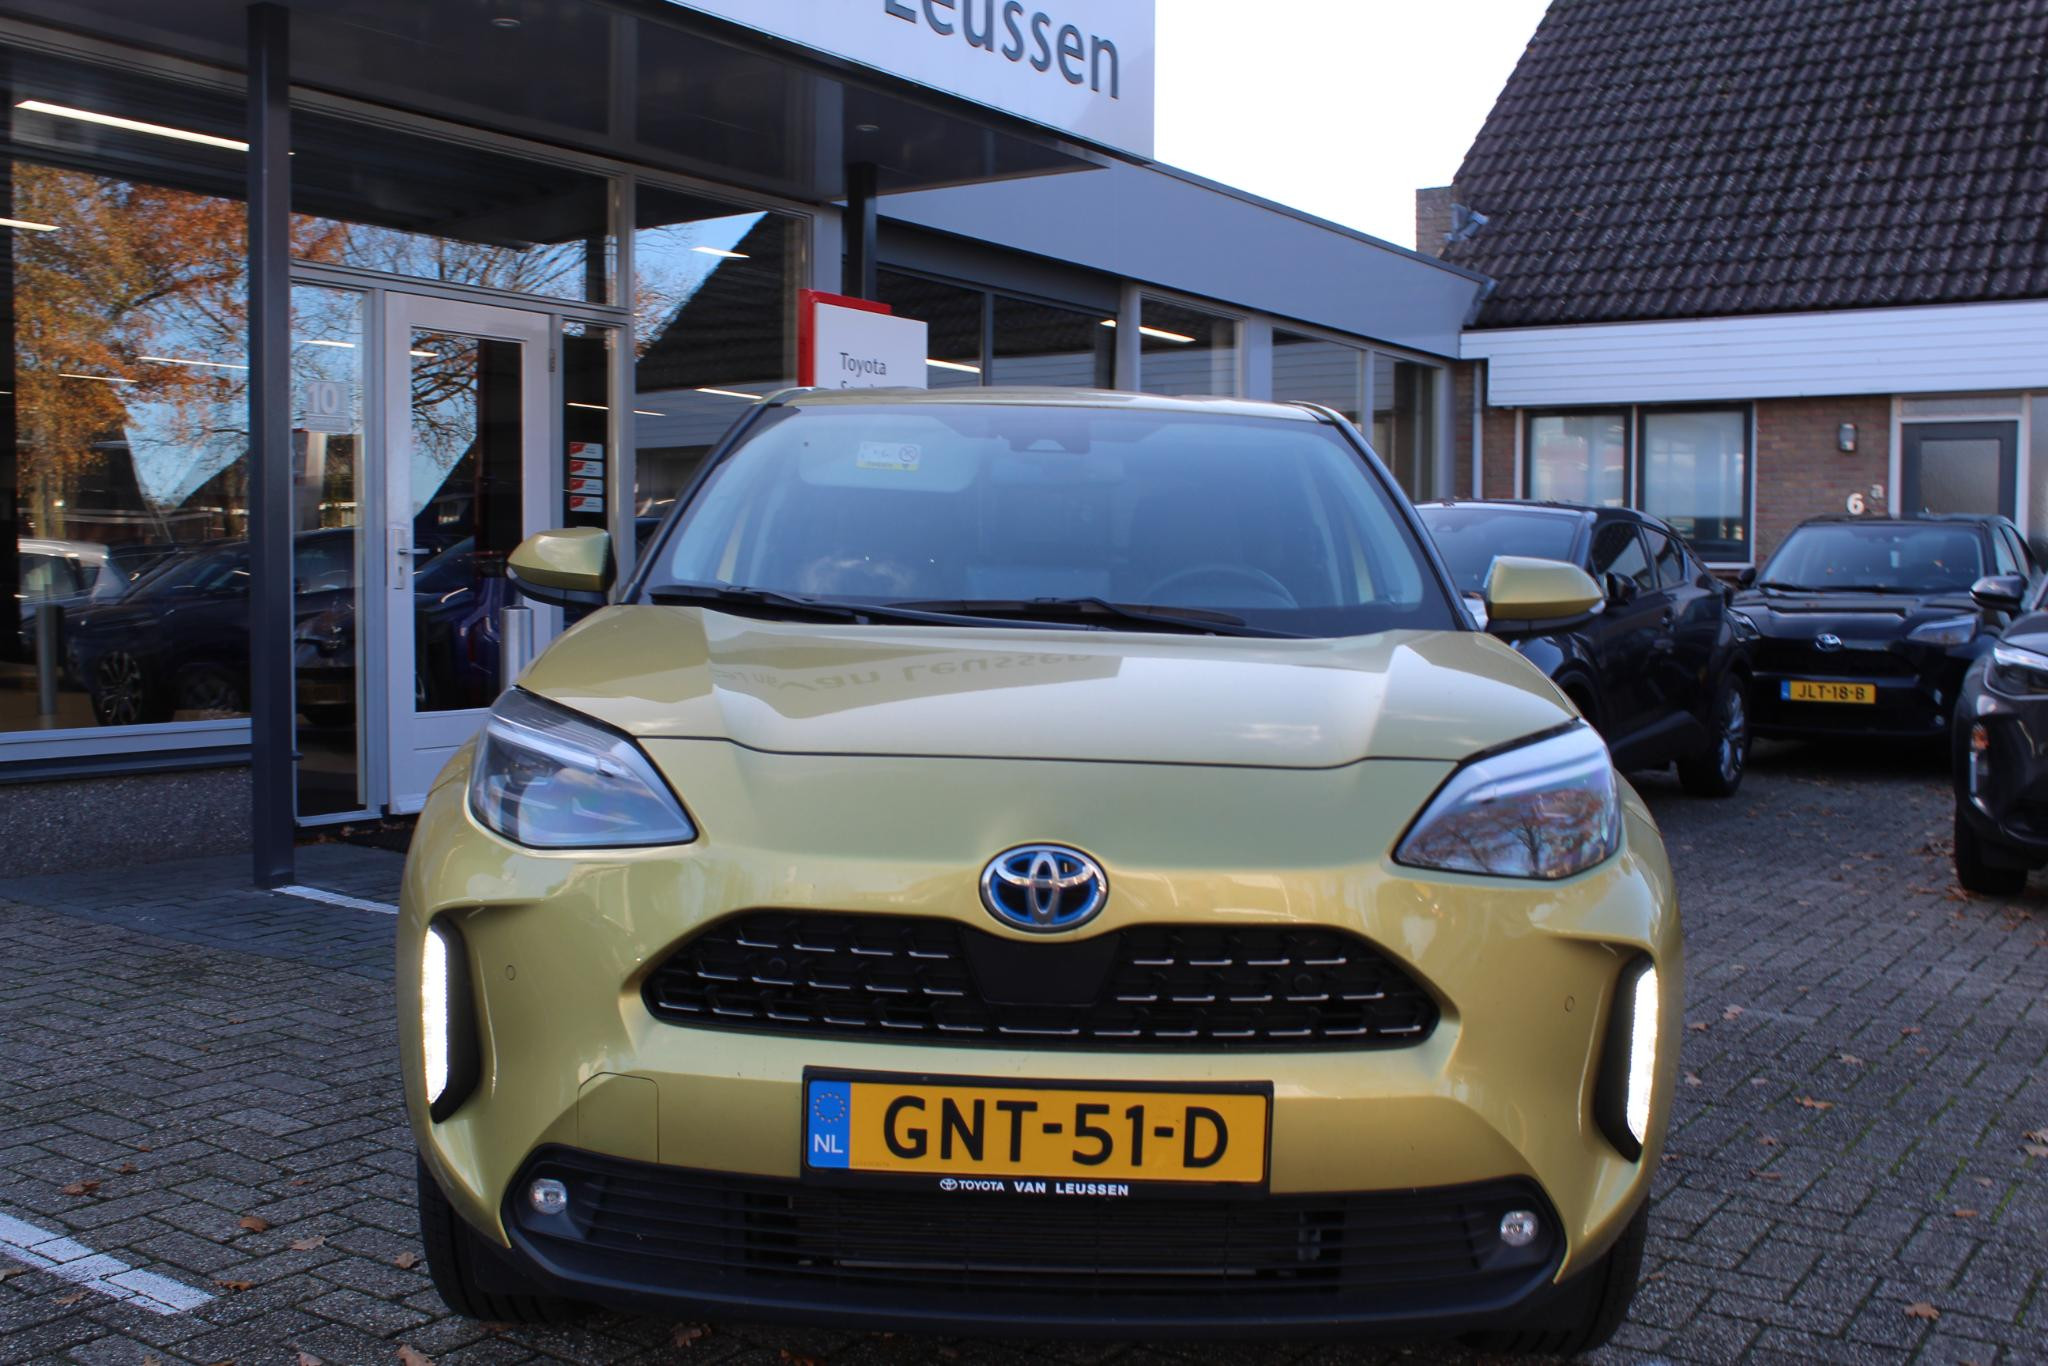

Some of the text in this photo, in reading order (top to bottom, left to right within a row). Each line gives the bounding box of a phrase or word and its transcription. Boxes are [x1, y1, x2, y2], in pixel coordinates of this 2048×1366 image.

[885, 0, 1119, 100] eussen
[840, 352, 887, 378] Toyota
[309, 383, 337, 414] 10
[1846, 484, 1884, 515] 6 a
[1798, 683, 1865, 700] JLT-18-B
[814, 1133, 843, 1154] NL
[883, 1095, 1228, 1169] GNT-51-D
[958, 1179, 1129, 1196] TOYOTA VAN LEUSSEN
